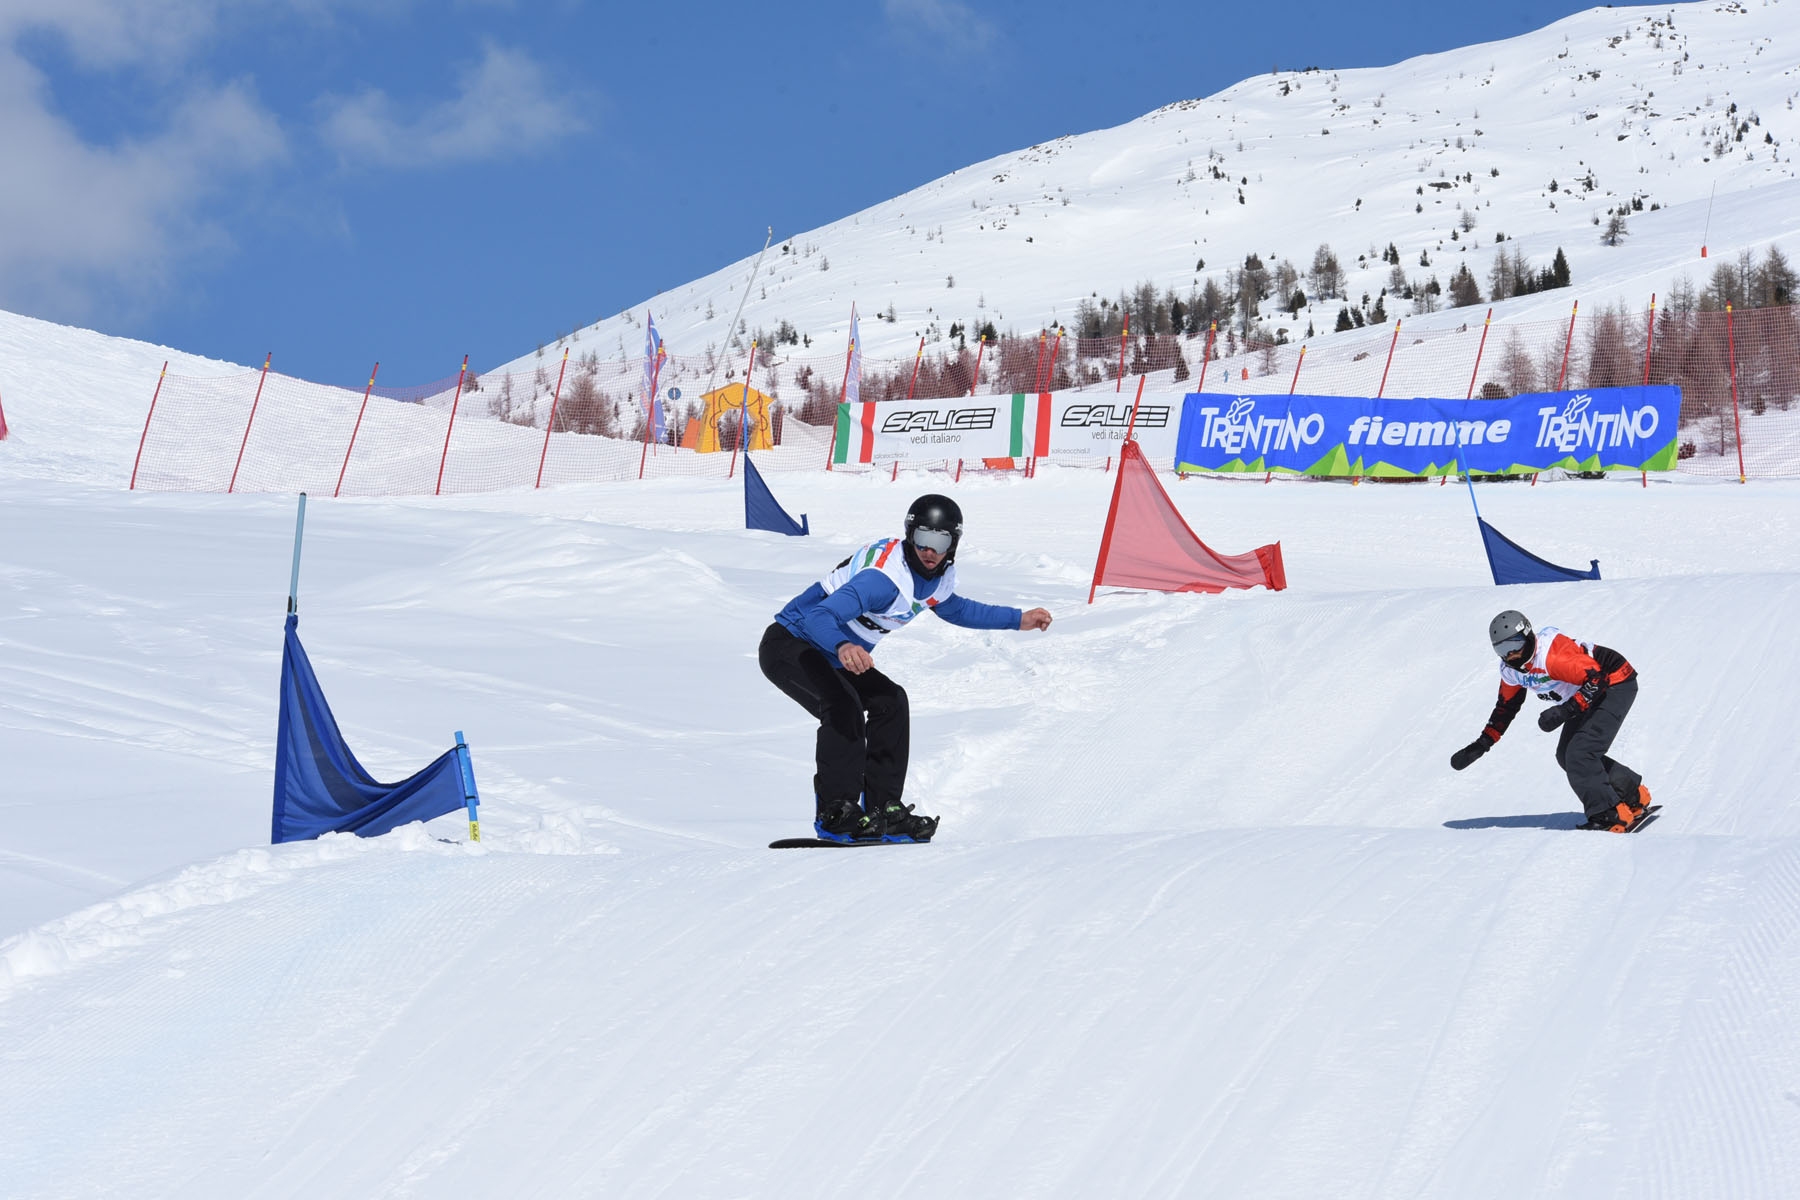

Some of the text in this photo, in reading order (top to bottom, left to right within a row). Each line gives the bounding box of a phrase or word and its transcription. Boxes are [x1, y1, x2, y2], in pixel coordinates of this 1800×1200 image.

[881, 408, 996, 433] SALICE
[1200, 407, 1325, 454] TRENTINO
[1348, 415, 1512, 446] fiemme
[1535, 404, 1659, 453] TRENTINO
[910, 432, 961, 444] vedi italiano
[1091, 430, 1107, 440] vedi
